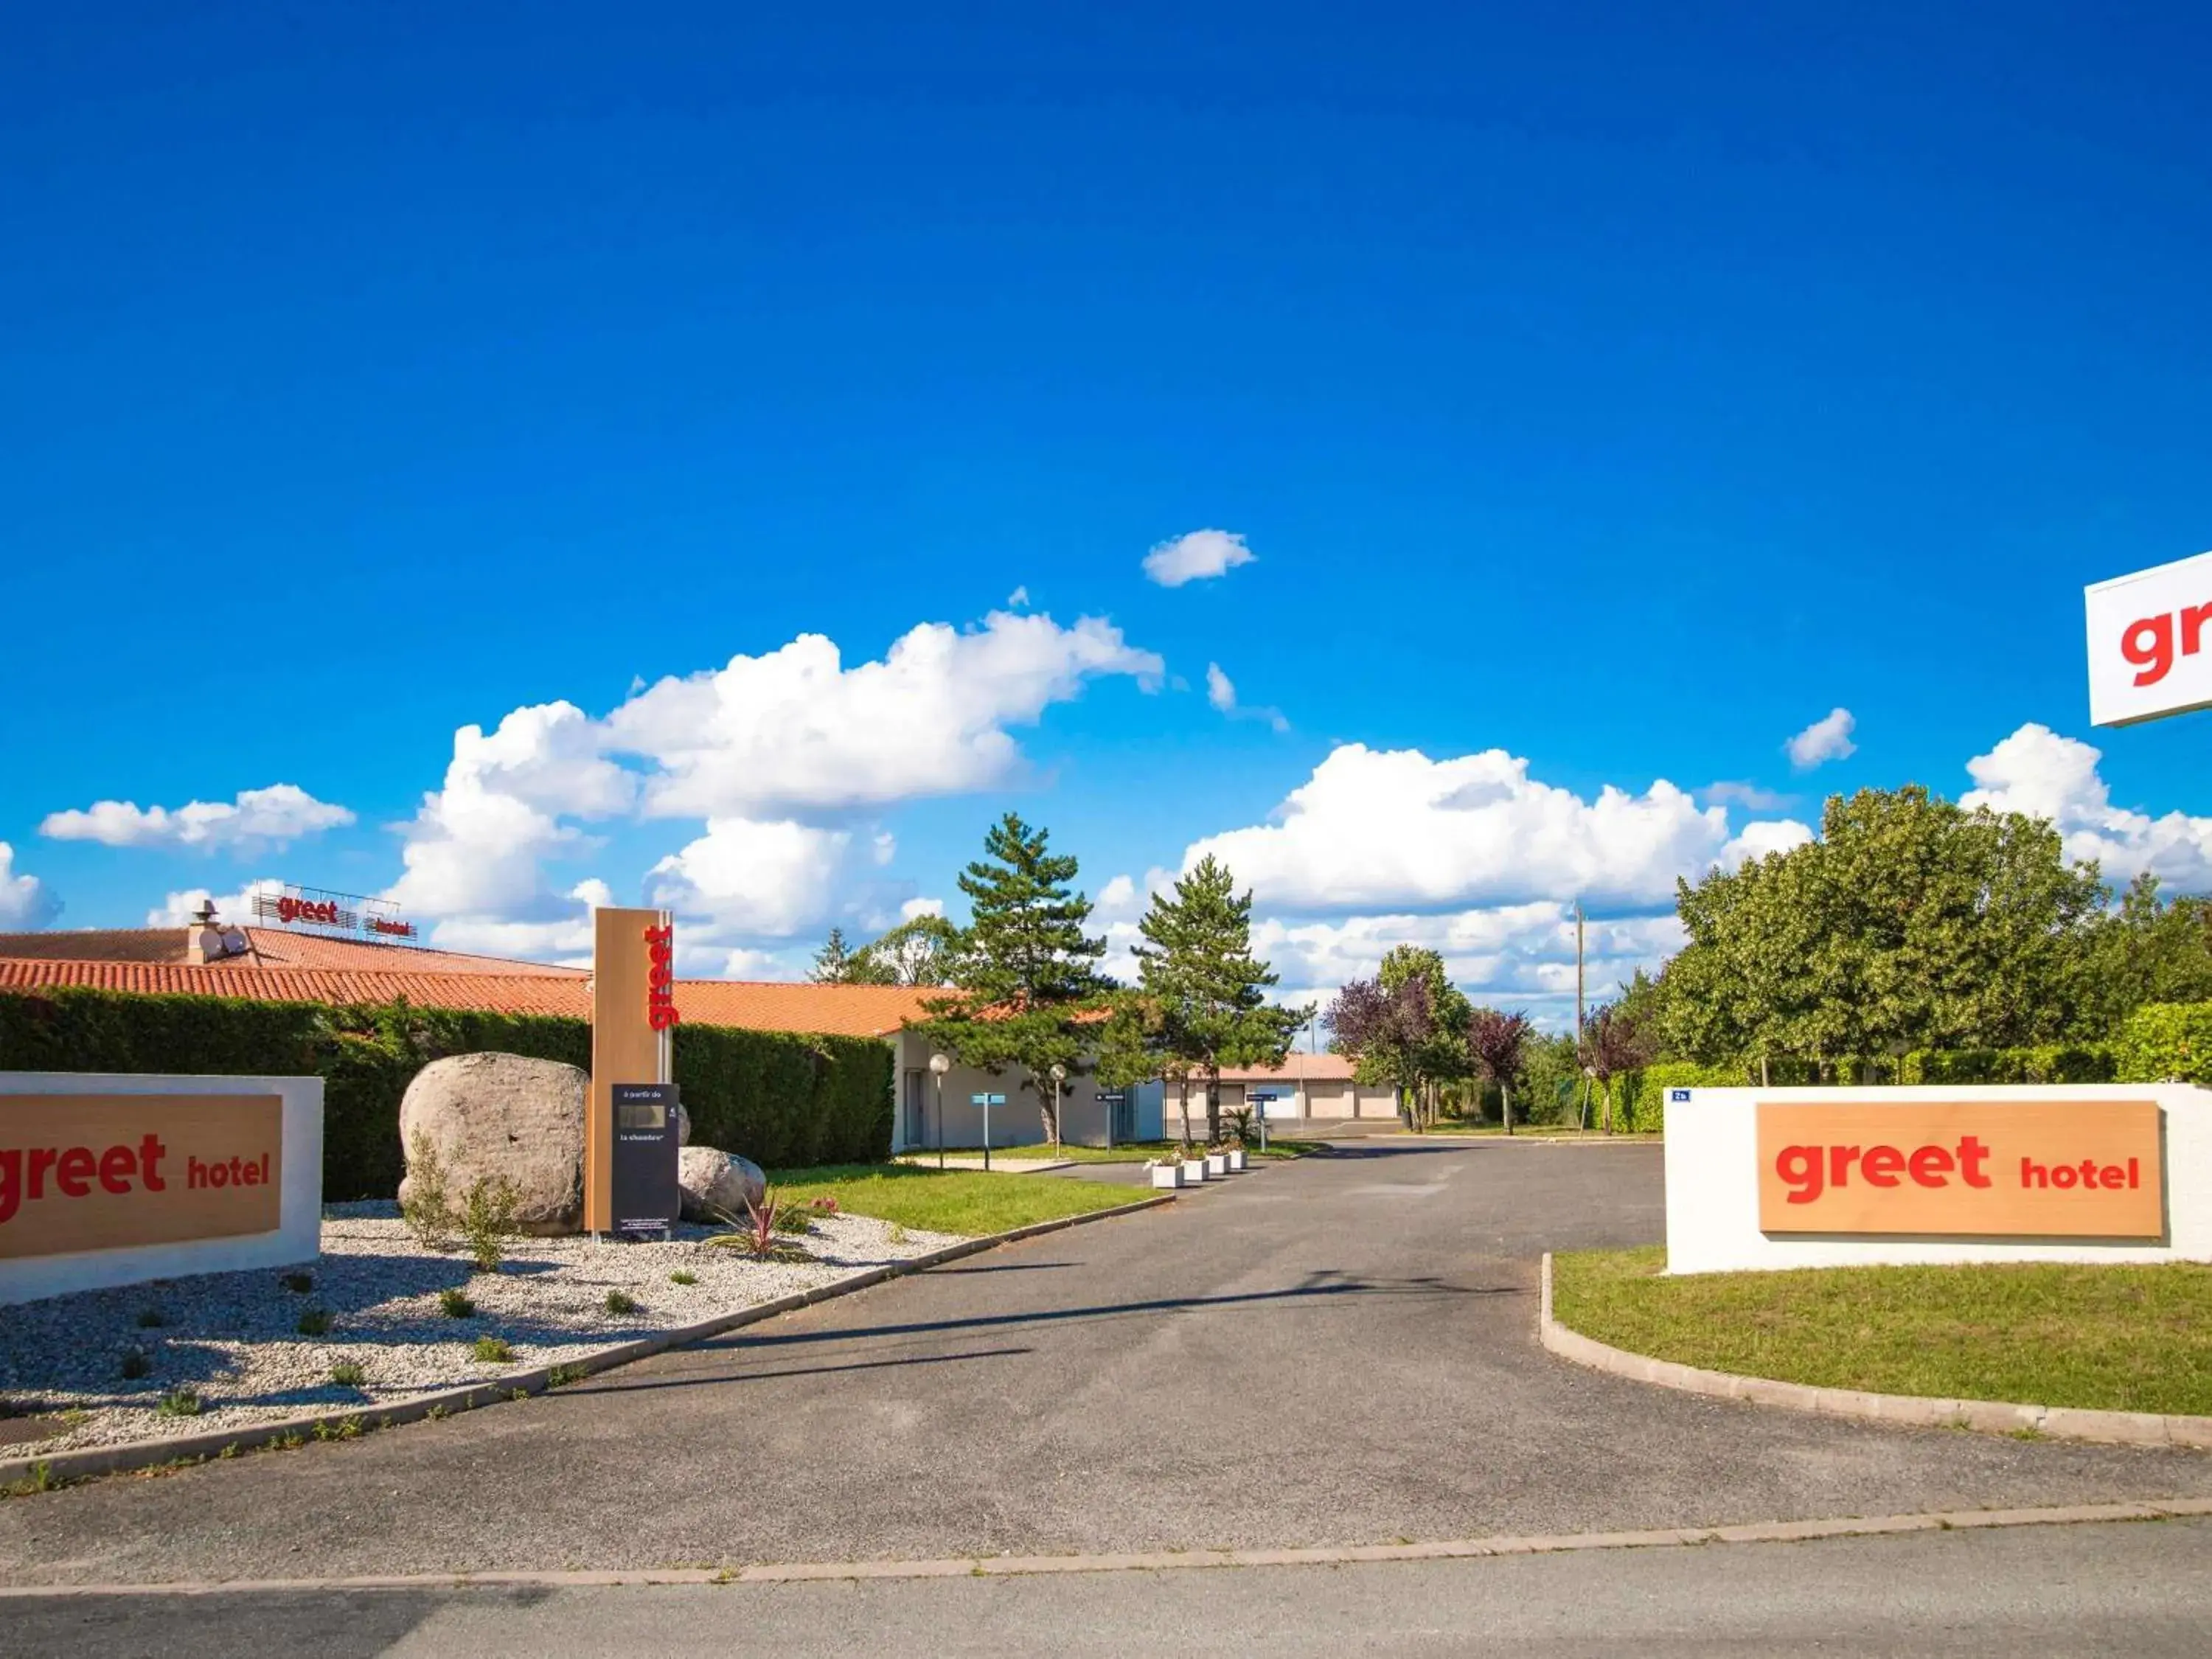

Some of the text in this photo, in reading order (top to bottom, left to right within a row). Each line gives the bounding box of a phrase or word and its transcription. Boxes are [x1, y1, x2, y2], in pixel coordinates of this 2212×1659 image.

[277, 897, 408, 936] greet hotel
[644, 925, 680, 1030] greet
[187, 1153, 270, 1189] hotel
[1775, 1135, 2140, 1203] greet hotel
